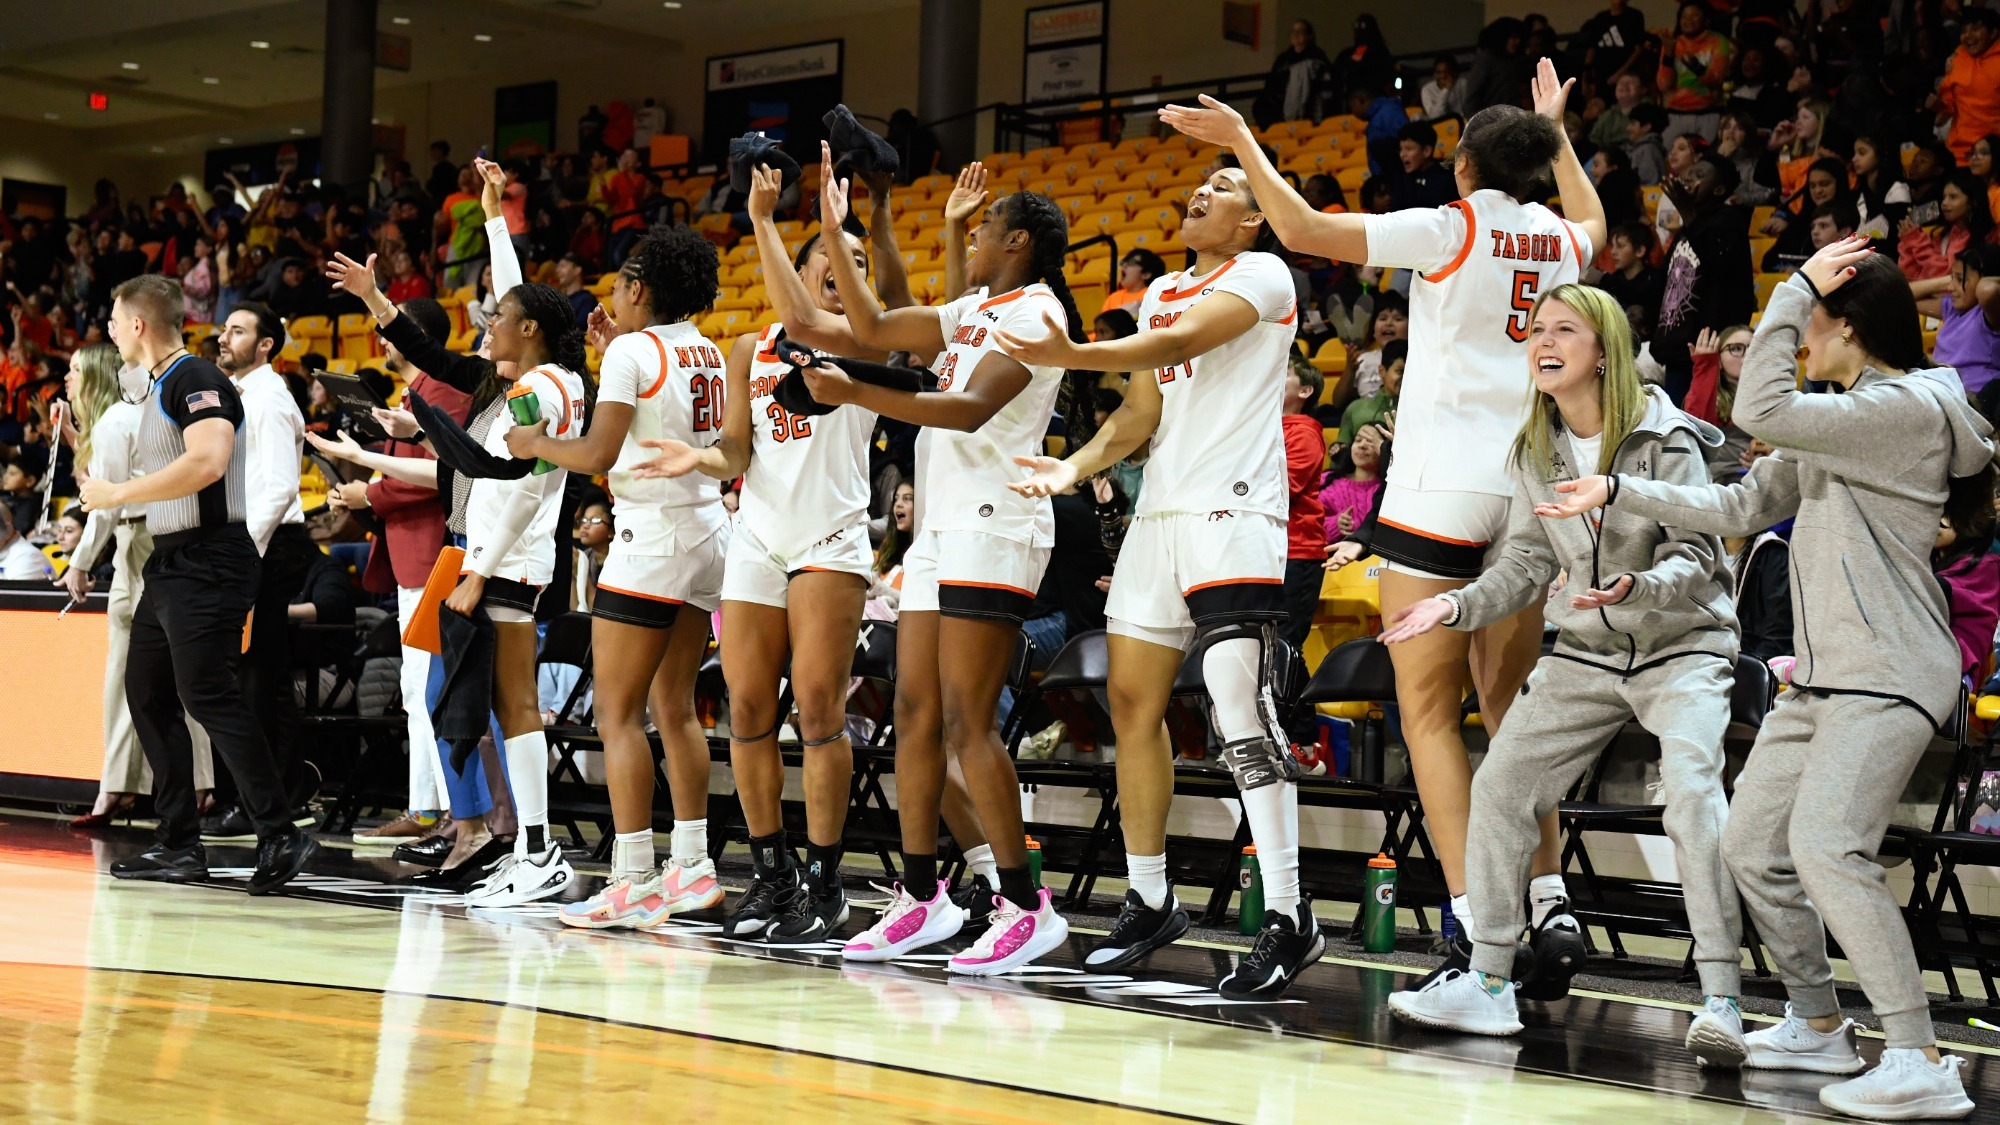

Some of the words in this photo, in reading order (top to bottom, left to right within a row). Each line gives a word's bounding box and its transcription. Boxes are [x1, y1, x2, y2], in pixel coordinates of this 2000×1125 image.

[1491, 229, 1561, 262] TABORN
[1505, 270, 1540, 343] 5
[690, 373, 725, 432] 20
[767, 402, 812, 443] 32
[1240, 868, 1252, 889] G
[1375, 883, 1394, 905] G
